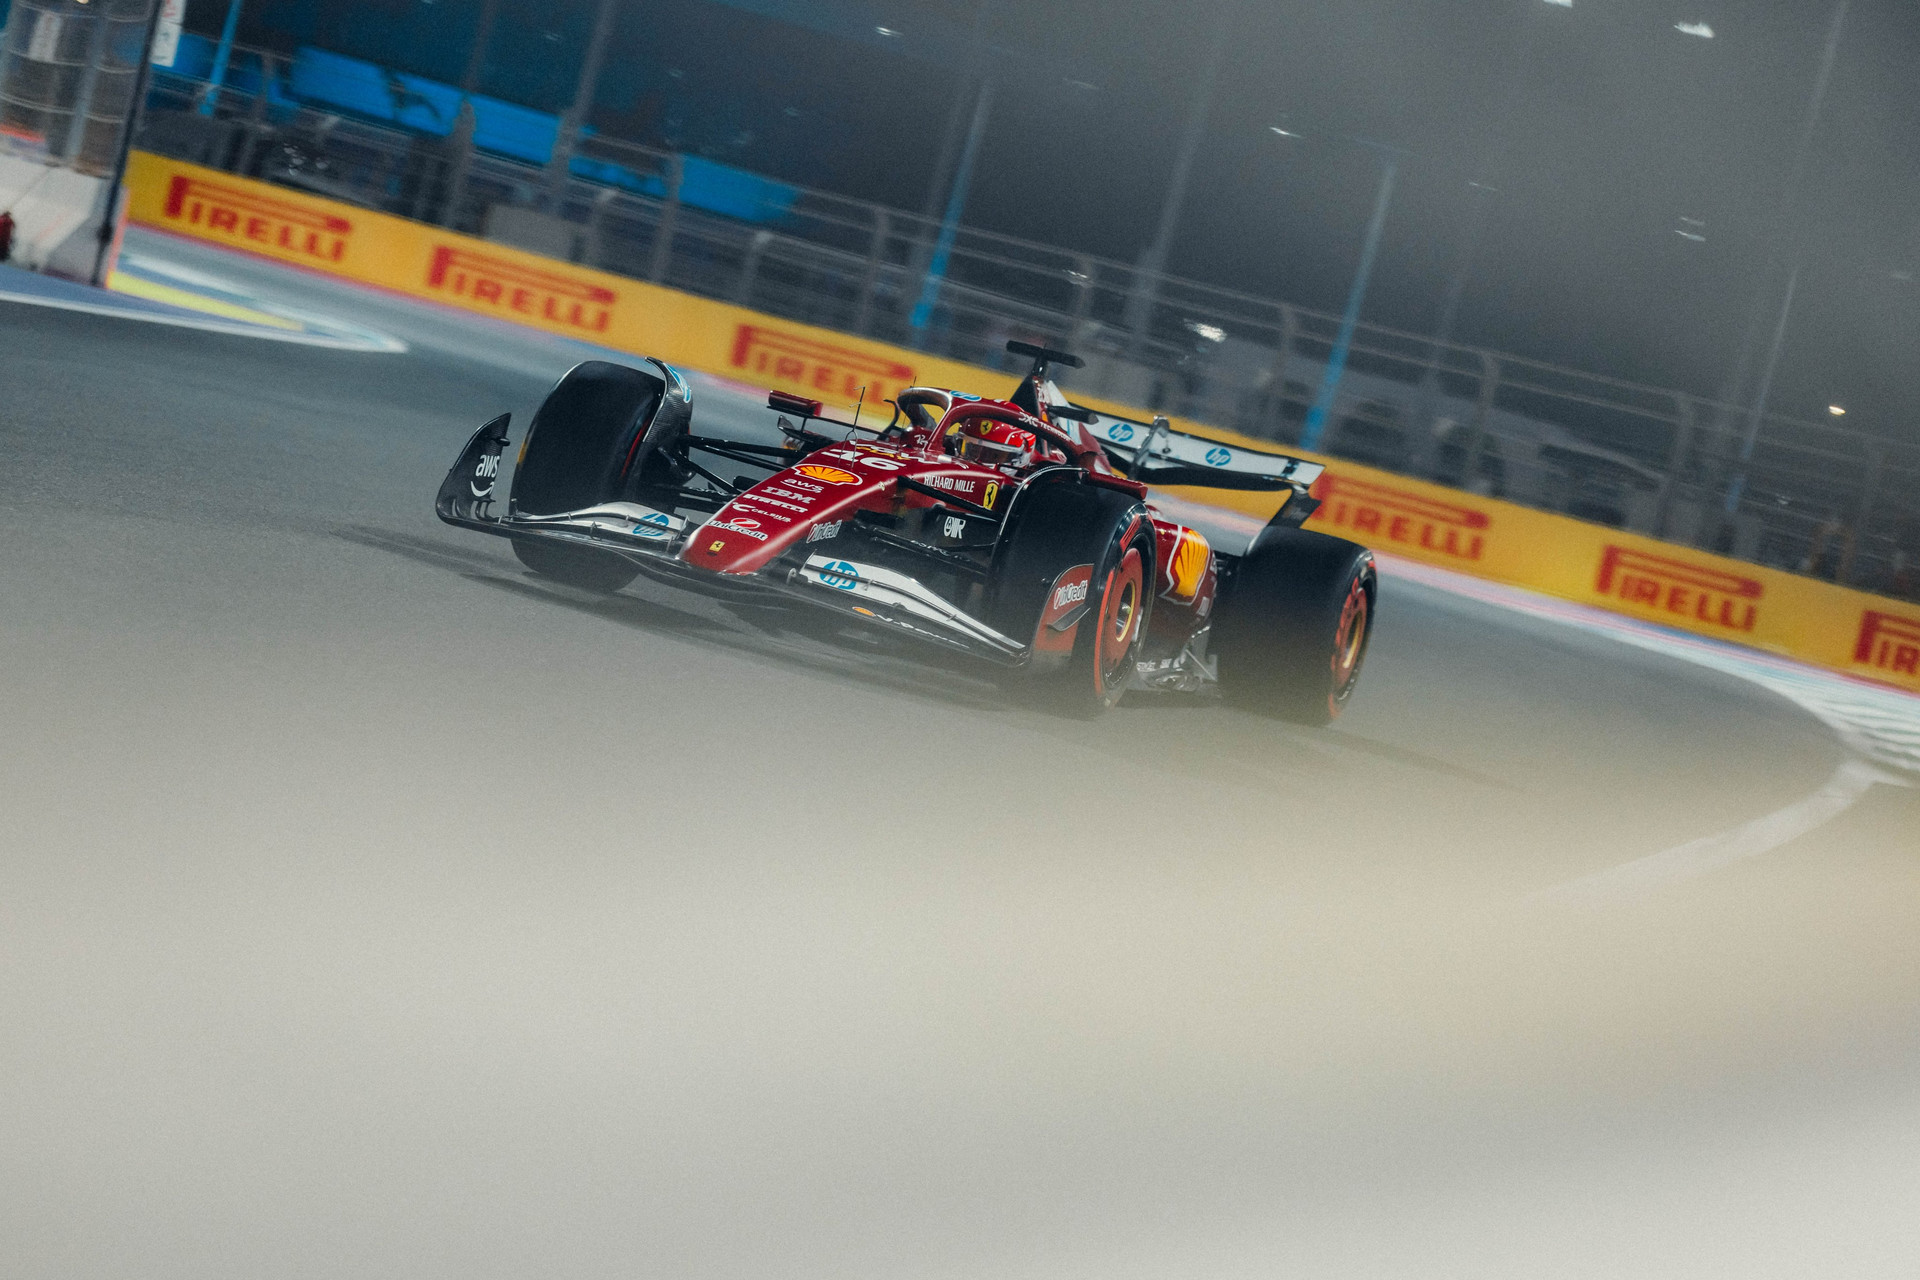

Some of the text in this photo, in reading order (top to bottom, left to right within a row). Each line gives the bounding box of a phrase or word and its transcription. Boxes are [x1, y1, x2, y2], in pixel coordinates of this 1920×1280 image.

[164, 174, 352, 262] PIRELLI
[427, 245, 616, 332] PIRELLI
[731, 323, 914, 405] PIRELL
[1108, 423, 1134, 442] hp
[475, 454, 500, 478] aws
[1205, 447, 1231, 466] hp
[783, 478, 825, 493] aws
[924, 474, 976, 493] RICHARD MILLE
[742, 494, 808, 513] PIRELLI
[761, 486, 817, 504] IBM
[1310, 472, 1491, 560] PIRELLI
[708, 520, 767, 541] UniCredit
[819, 560, 859, 591] hp
[1595, 545, 1764, 632] PIRELLI
